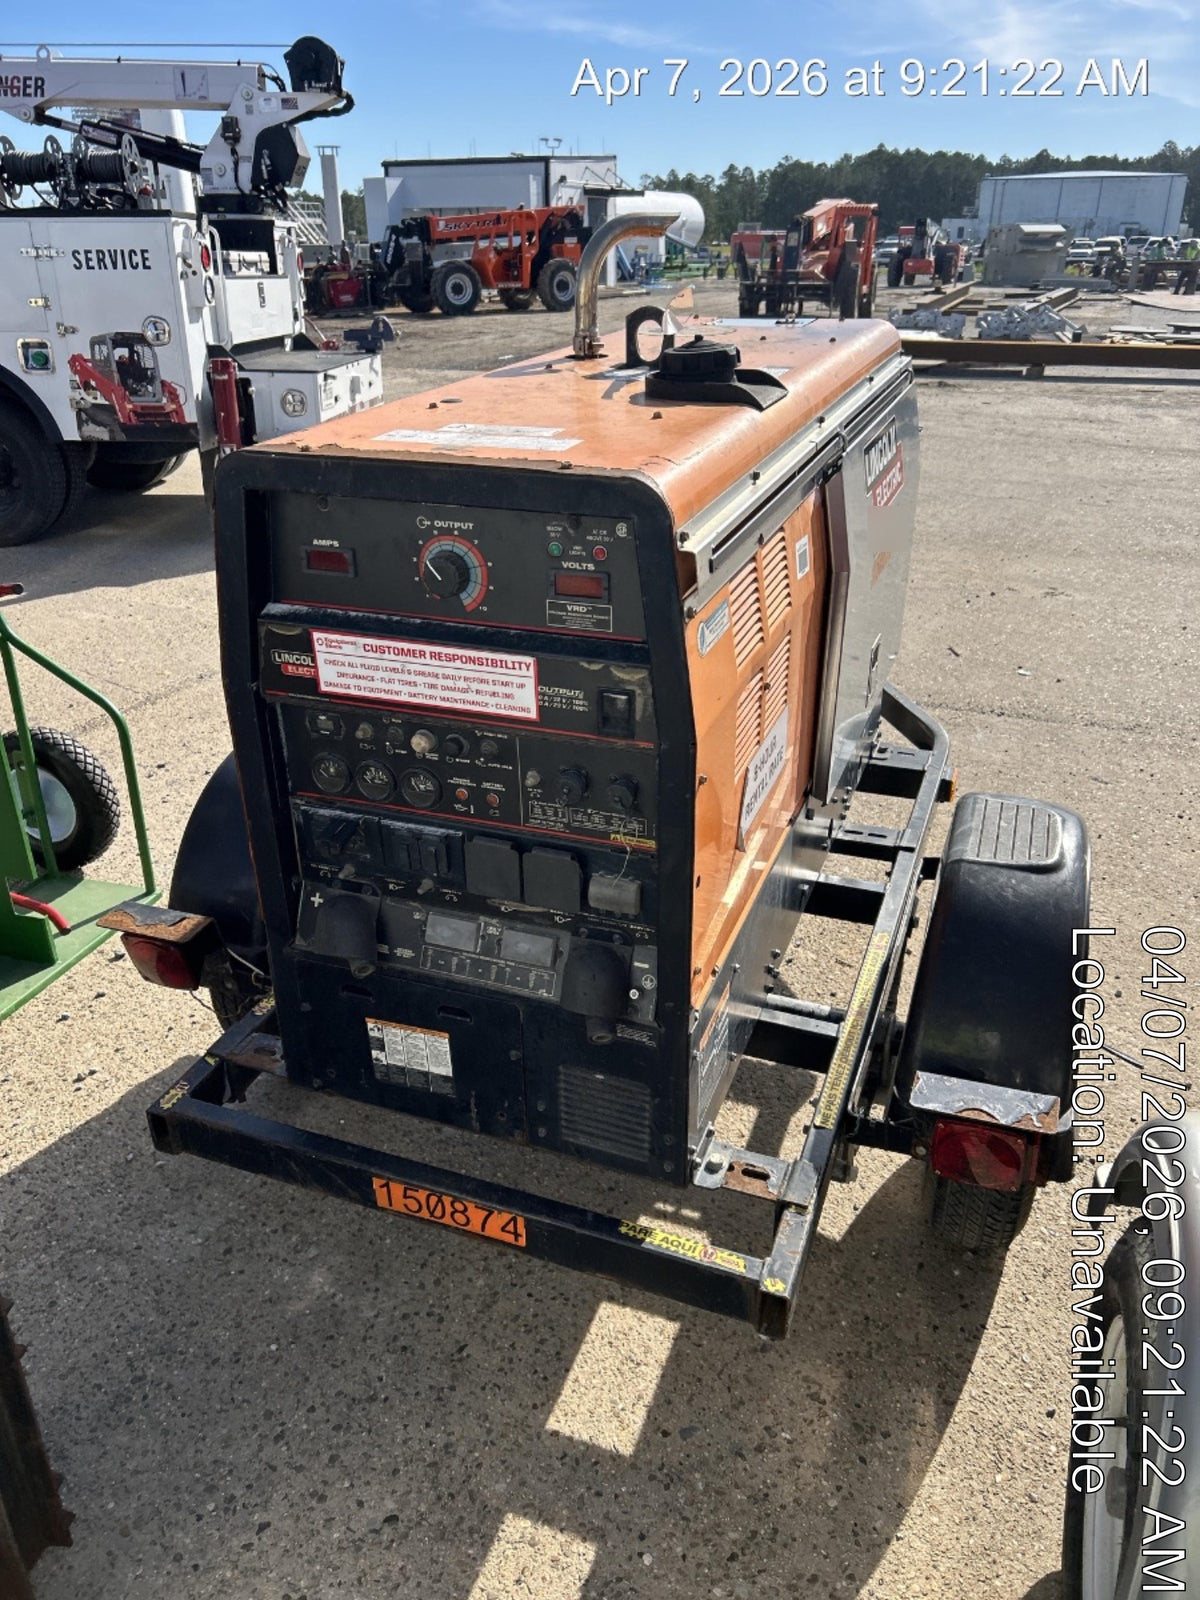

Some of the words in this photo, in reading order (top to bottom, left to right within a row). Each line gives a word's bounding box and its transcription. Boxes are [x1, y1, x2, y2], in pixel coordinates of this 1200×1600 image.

[72, 248, 152, 270] SERVICE
[434, 519, 474, 530] OUTPUT
[312, 539, 340, 547] AMPS
[561, 561, 596, 571] VOLTS
[274, 652, 316, 666] LINCOL
[363, 643, 427, 660] CUSTOMER
[429, 651, 532, 672] RESPONSIBILITY
[287, 665, 316, 677] ELECT
[324, 659, 346, 668] CHECK
[360, 664, 381, 672] FLUID
[382, 666, 406, 675] LEVELS
[413, 670, 440, 680] GREASE
[442, 673, 462, 681] DAILY
[463, 676, 490, 686] BEFORE
[492, 680, 514, 689] START
[336, 671, 376, 682] INSURANCE
[380, 677, 396, 685] FLAT
[398, 679, 418, 688] TIRES
[423, 682, 439, 690] TIRE
[441, 684, 470, 694] DAMAGE
[475, 688, 515, 700] REFUELING
[323, 681, 351, 690] DAMAGE
[363, 686, 403, 697] EQUIPMENT
[408, 692, 438, 701] BATTERY
[439, 696, 491, 709] MAINTENANCE
[495, 703, 532, 714] CLEANING
[831, 1063, 846, 1092] TENEZ
[824, 1093, 838, 1112] PAS
[820, 1111, 832, 1126] NE
[379, 1181, 523, 1243] 150874
